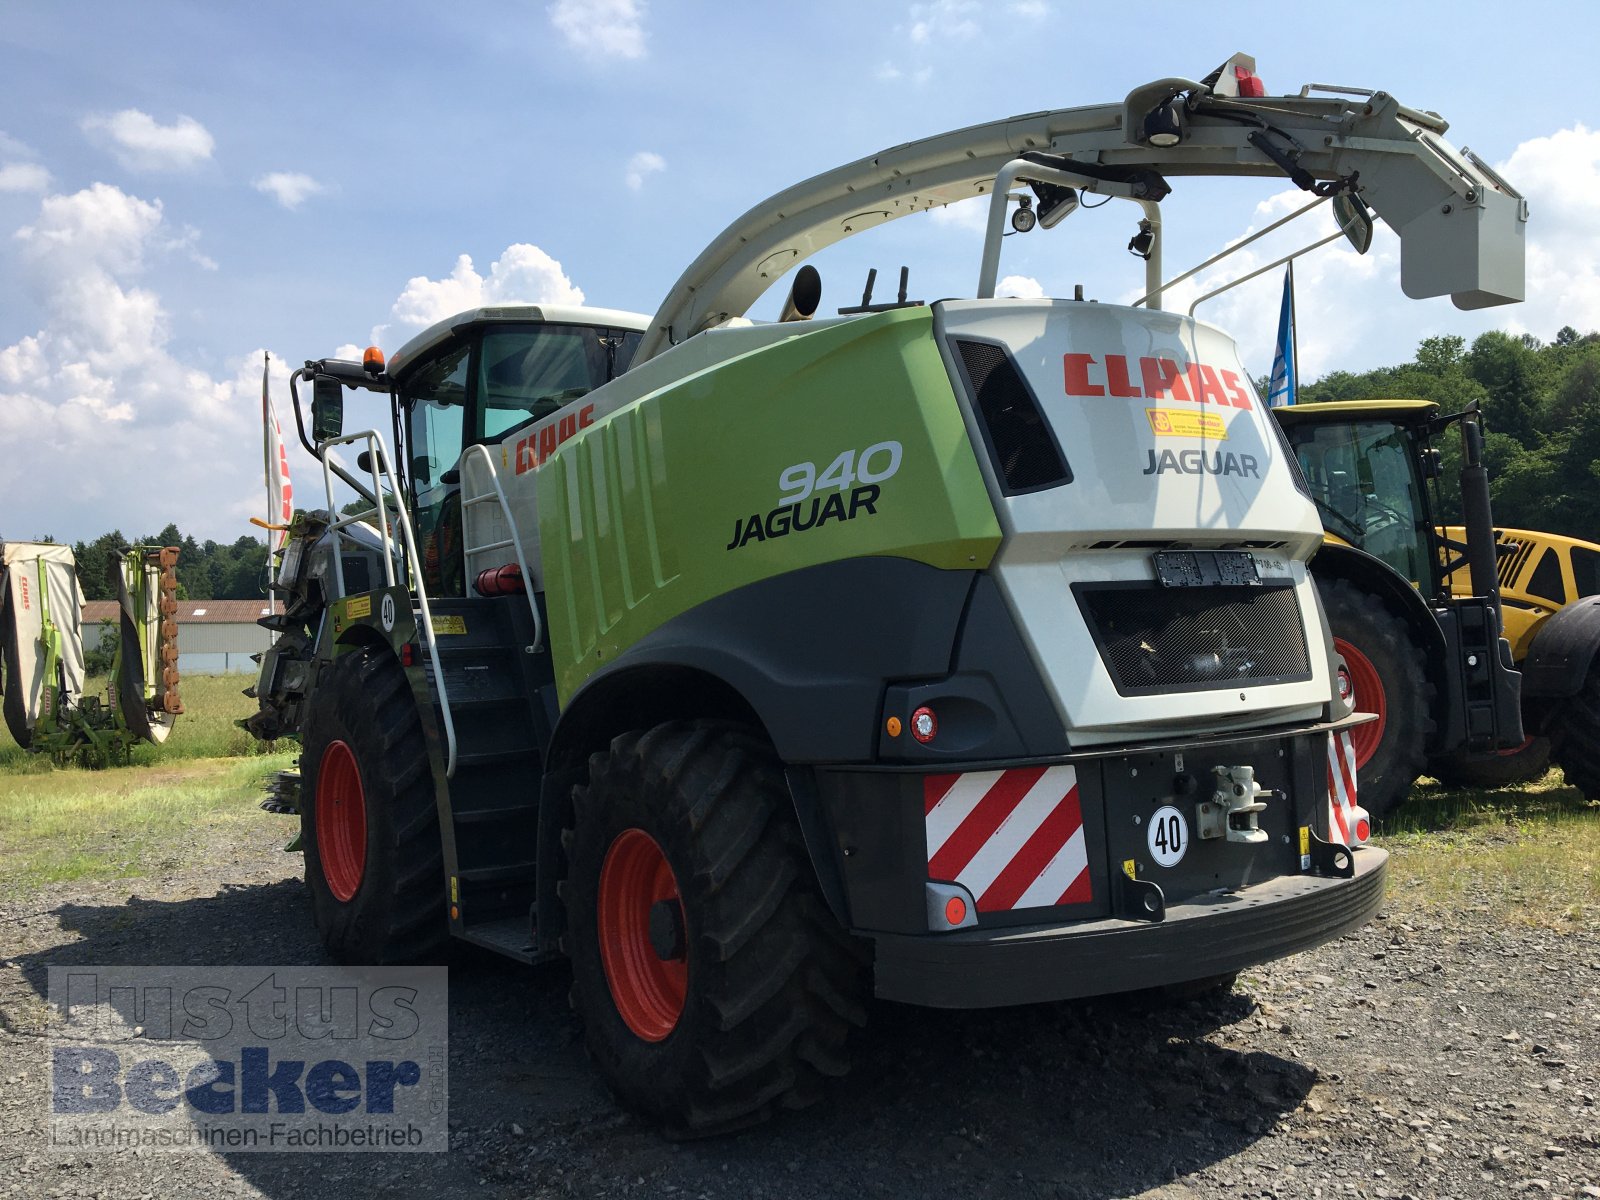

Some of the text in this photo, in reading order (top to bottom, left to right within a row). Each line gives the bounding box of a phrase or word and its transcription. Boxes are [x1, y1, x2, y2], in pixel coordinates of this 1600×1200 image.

[1063, 353, 1253, 411] CLAAS
[778, 440, 903, 507] 940
[1143, 449, 1260, 479] JAGUAR
[727, 484, 881, 551] JAGUAR
[21, 576, 30, 610] CLAAS
[383, 599, 393, 622] 40
[1155, 815, 1181, 855] 40
